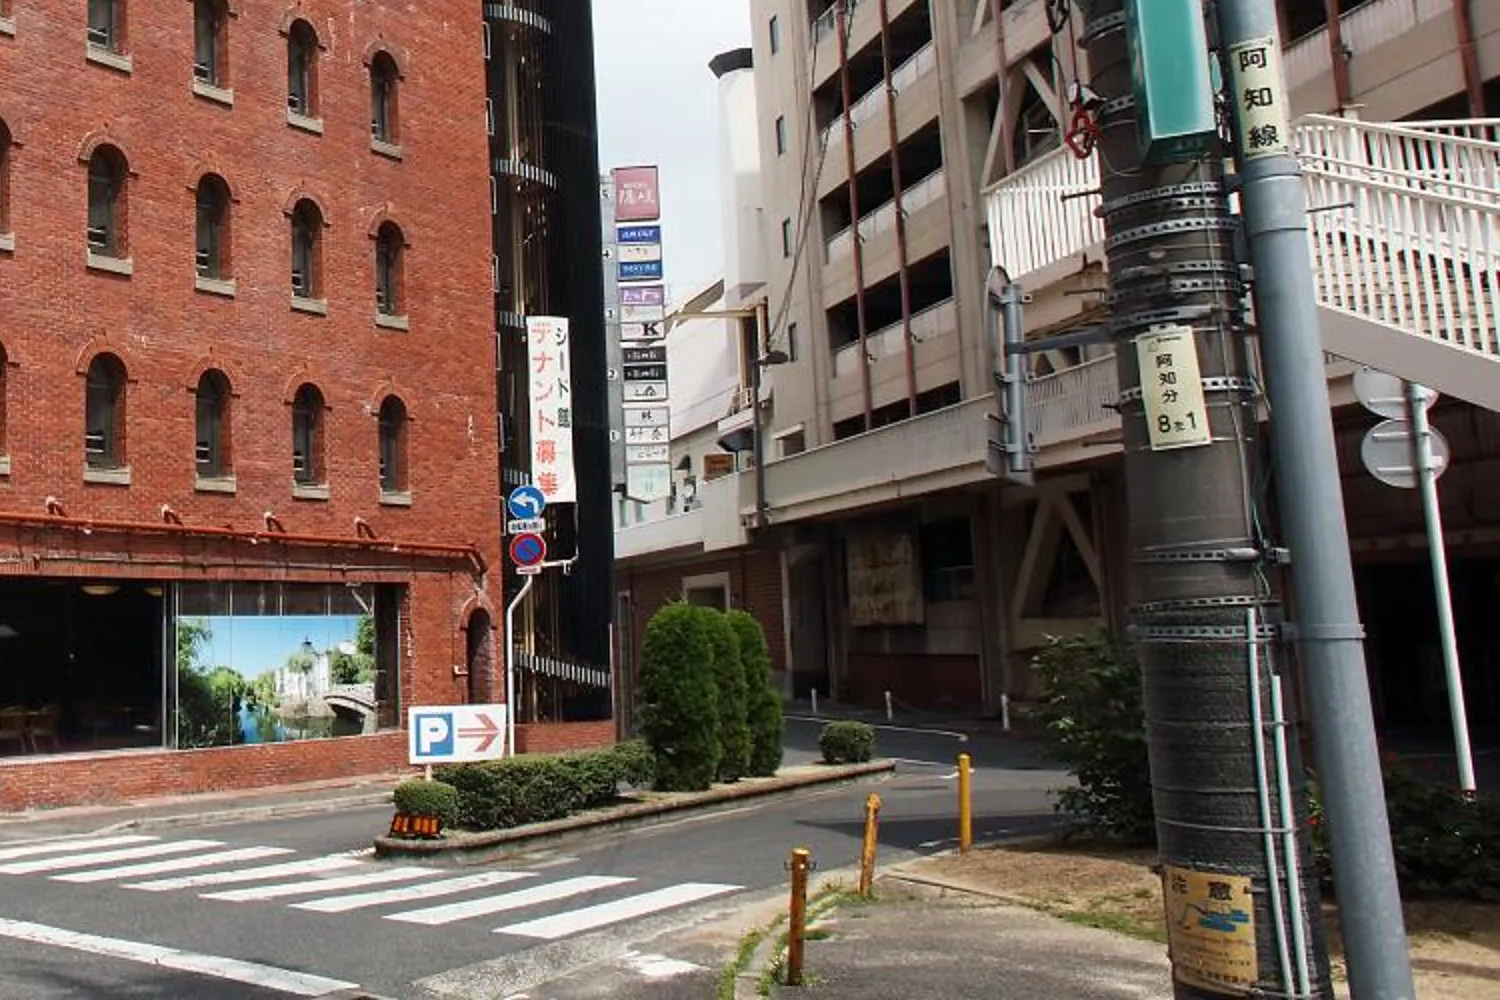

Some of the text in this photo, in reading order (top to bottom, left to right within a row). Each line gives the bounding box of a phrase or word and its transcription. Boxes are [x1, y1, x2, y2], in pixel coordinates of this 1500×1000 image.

[1239, 47, 1279, 149] 阿知線
[1156, 353, 1179, 403] 阿知分
[419, 717, 449, 753] P
